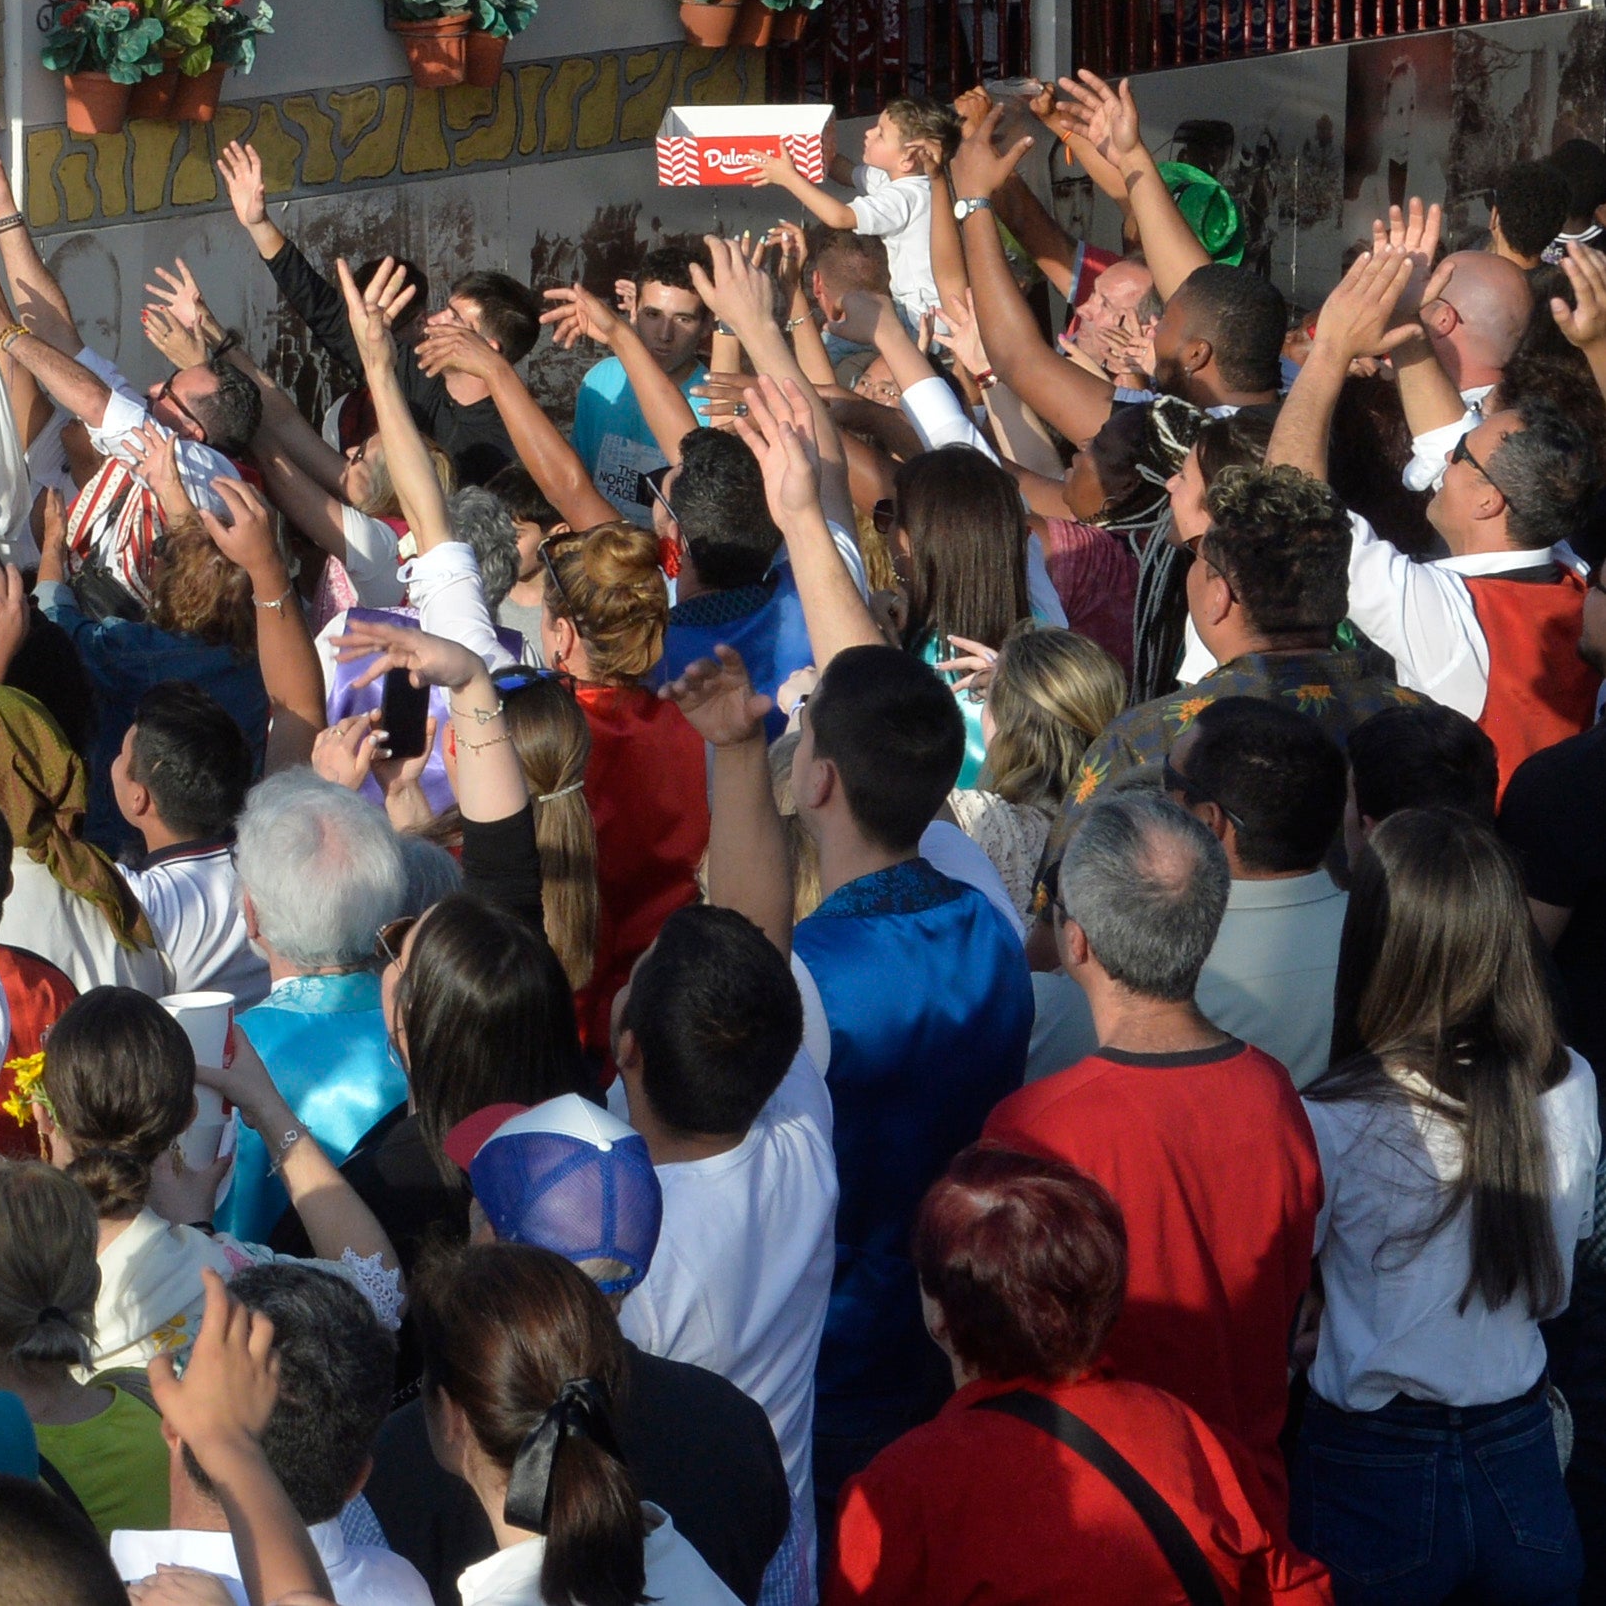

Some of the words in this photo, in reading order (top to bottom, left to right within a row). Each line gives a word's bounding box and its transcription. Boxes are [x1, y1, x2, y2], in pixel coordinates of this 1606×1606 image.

[599, 471, 638, 489] NORTH
[618, 464, 638, 482] THE
[606, 485, 636, 503] FACE
